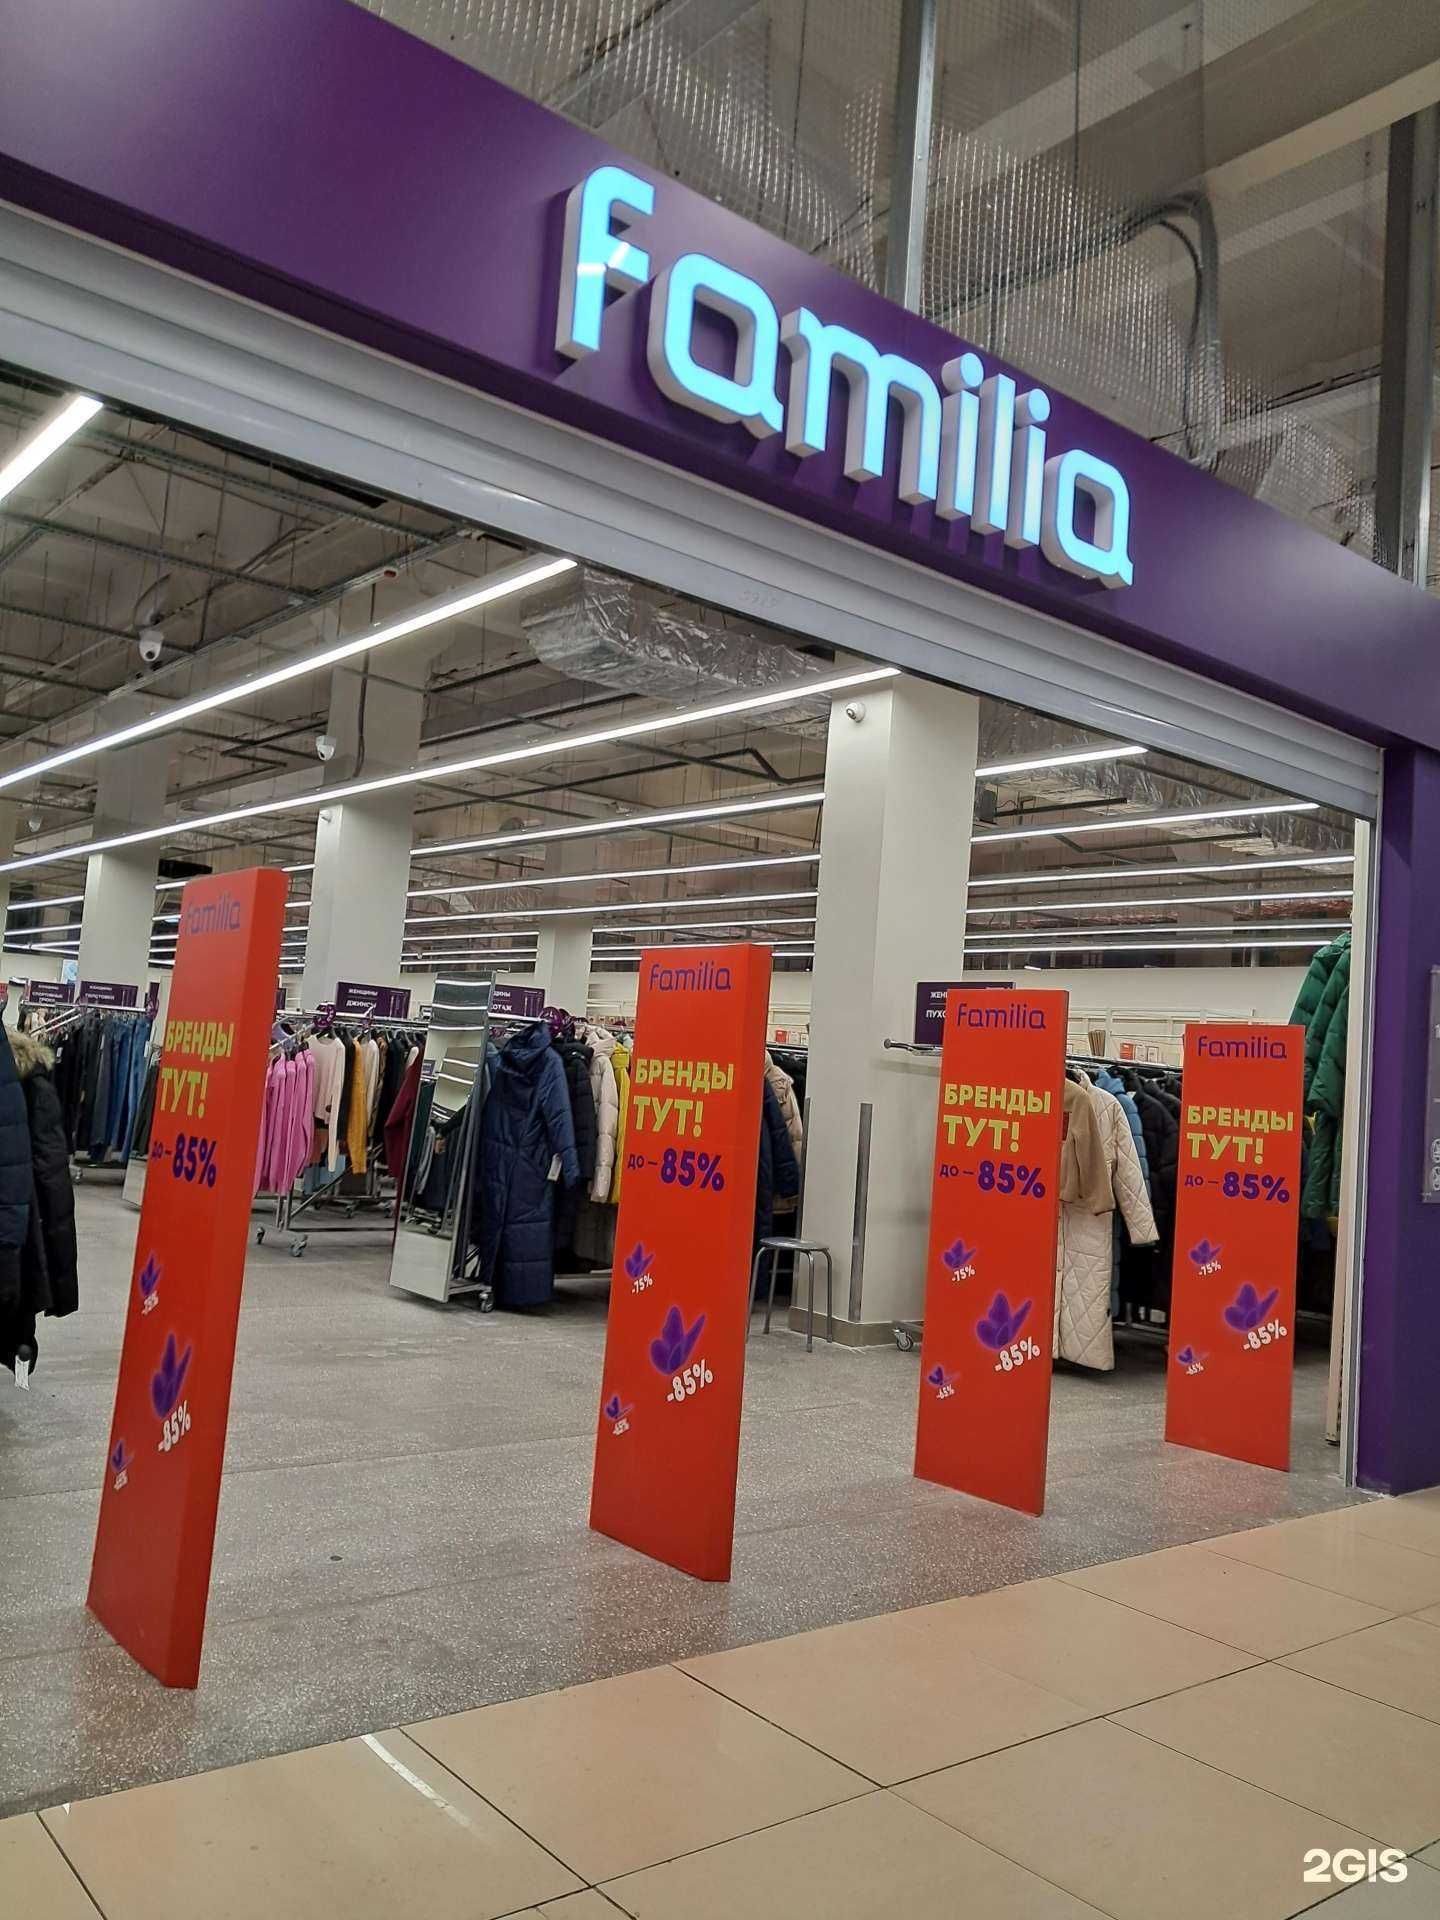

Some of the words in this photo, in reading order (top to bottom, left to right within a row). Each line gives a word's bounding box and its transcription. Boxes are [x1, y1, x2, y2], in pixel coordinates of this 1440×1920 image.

[491, 1003, 513, 1011] ОТАЖ
[165, 1020, 235, 1063] БРЕНДЫ
[160, 1067, 208, 1119] ТУТ!
[635, 1058, 734, 1094] БРЕНДЫ
[633, 1094, 704, 1138] ТУТ!
[944, 1083, 1051, 1116] БРЕНДЫ
[943, 1115, 1020, 1153] ТУТ!
[1187, 1105, 1294, 1133] БРЕНДЫ
[1186, 1132, 1264, 1165] ТУТ!
[632, 1273, 653, 1294] -75%
[951, 1265, 976, 1283] -75%
[1198, 1260, 1222, 1276] -75%
[1243, 1319, 1288, 1350] -85%
[994, 1336, 1040, 1372] -85%
[667, 1359, 714, 1402] -85%
[158, 1400, 191, 1451] -85%
